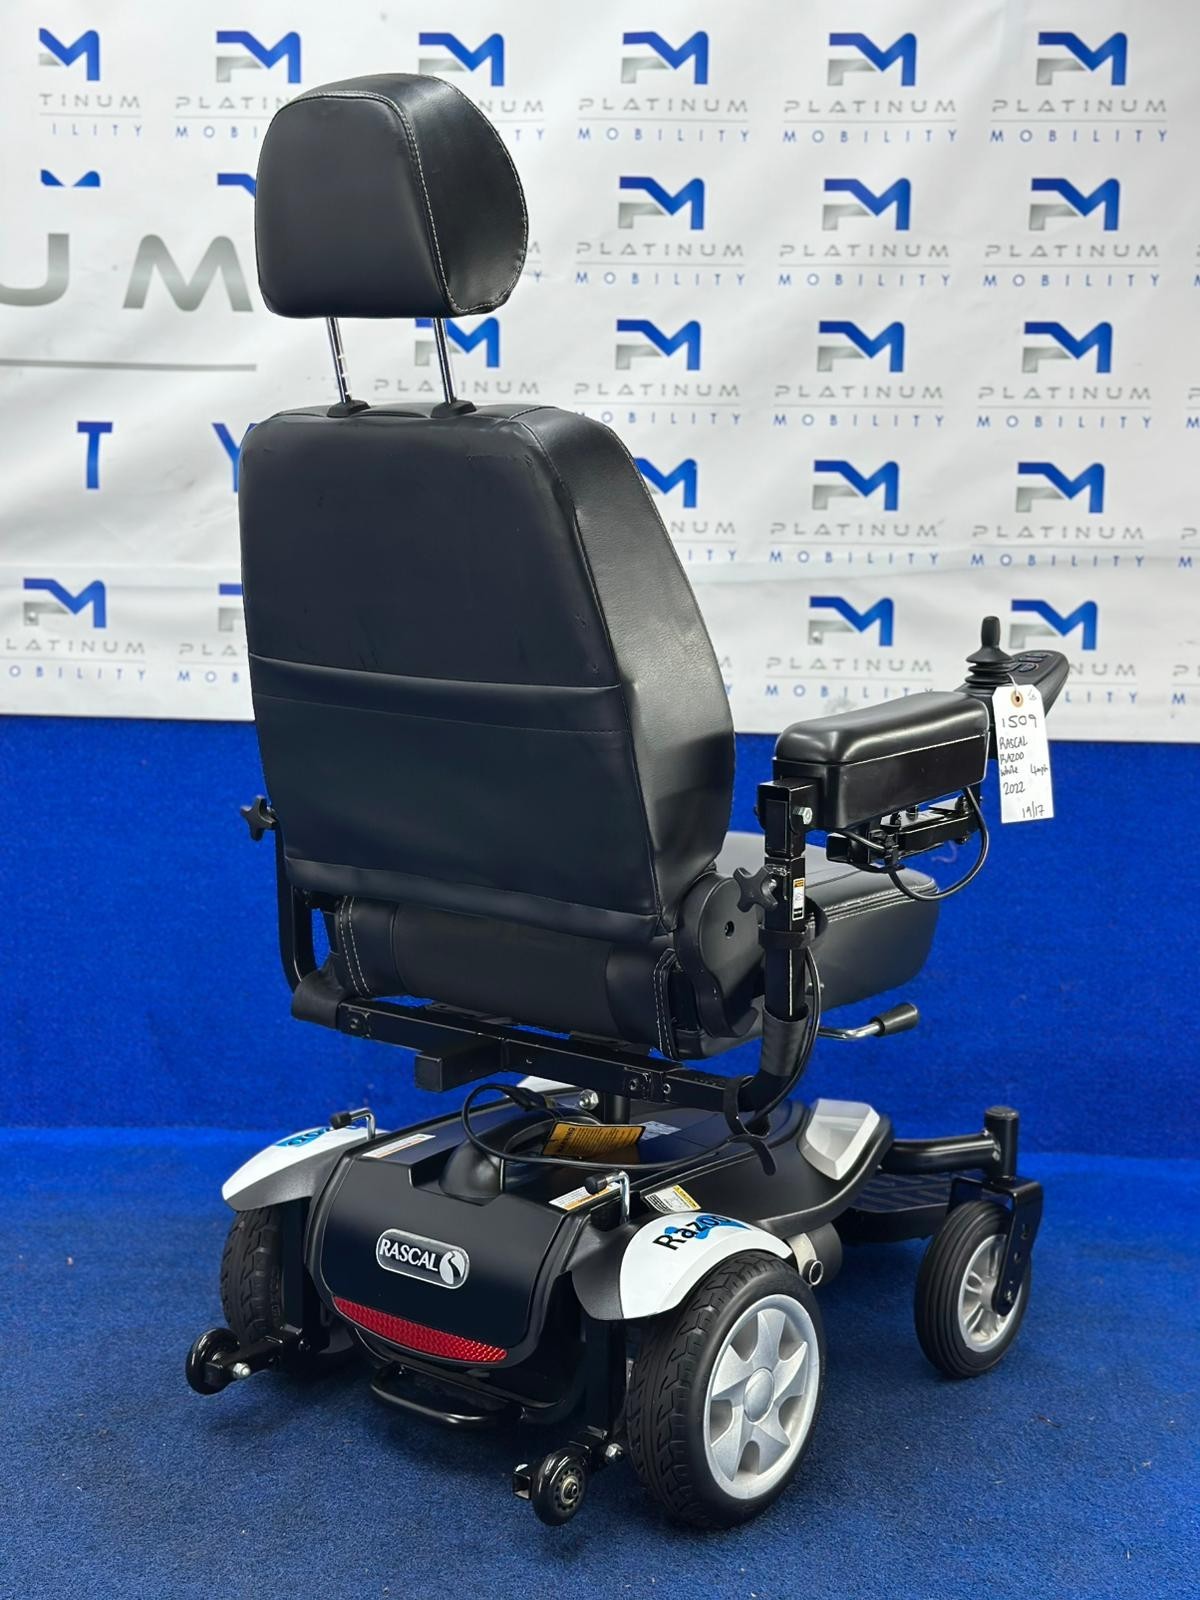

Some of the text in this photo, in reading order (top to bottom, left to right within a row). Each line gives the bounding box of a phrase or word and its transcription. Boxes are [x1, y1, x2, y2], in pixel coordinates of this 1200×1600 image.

[39, 93, 140, 108] TINUM
[578, 98, 748, 112] PLATINUM
[784, 100, 956, 114] PLATINUM
[992, 99, 1167, 113] PLATINUM
[52, 123, 142, 136] ILITY
[578, 128, 749, 142] MOBILITY
[783, 129, 957, 143] MOBILITY
[990, 129, 1167, 143] MOBILITY
[576, 242, 744, 257] PLATINUM
[780, 244, 949, 258] PLATINUM
[985, 244, 1158, 258] PLATINUM
[576, 272, 745, 286] MOBILITY
[778, 273, 950, 287] MOBILITY
[983, 273, 1159, 287] MOBILITY
[374, 378, 540, 394] PLAINUM
[574, 383, 740, 397] PLATINUM
[774, 385, 943, 399] PLATINUM
[978, 386, 1151, 400] PLATINUM
[773, 414, 944, 427] MOBILITY
[977, 415, 1151, 428] MOBILITY
[770, 523, 937, 537] PLATINUM
[972, 525, 1144, 540] PLATINUM
[769, 550, 940, 565] MOBILITY
[971, 553, 1144, 567] MOBILITY
[6, 638, 145, 654] LATINUM
[766, 657, 933, 672] PLATINUM
[9, 665, 146, 680] OBILITY
[1002, 714, 1037, 728] 1509
[1000, 736, 1027, 749] RASCAL
[1003, 781, 1025, 795] 2022
[380, 1239, 438, 1271] RASCAL
